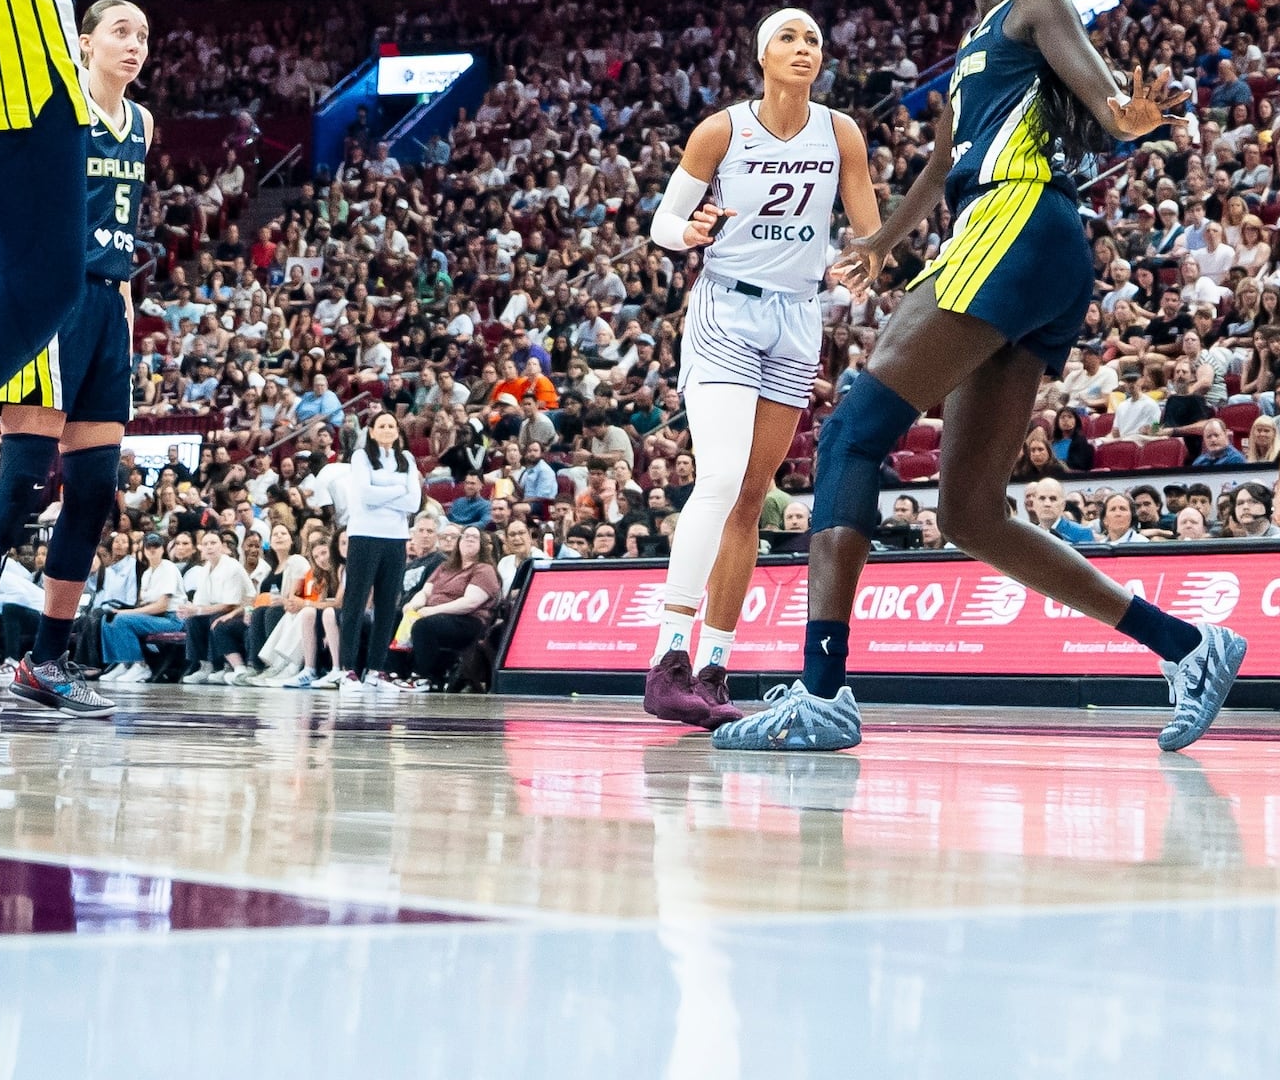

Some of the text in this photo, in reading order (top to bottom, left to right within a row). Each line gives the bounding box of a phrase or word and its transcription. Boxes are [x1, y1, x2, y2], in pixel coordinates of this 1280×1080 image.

[744, 161, 835, 174] TEMPO
[115, 183, 131, 225] 5
[758, 183, 816, 216] 21
[751, 224, 796, 240] CIBC
[537, 591, 590, 622] CIBC
[854, 585, 918, 620] CIBC
